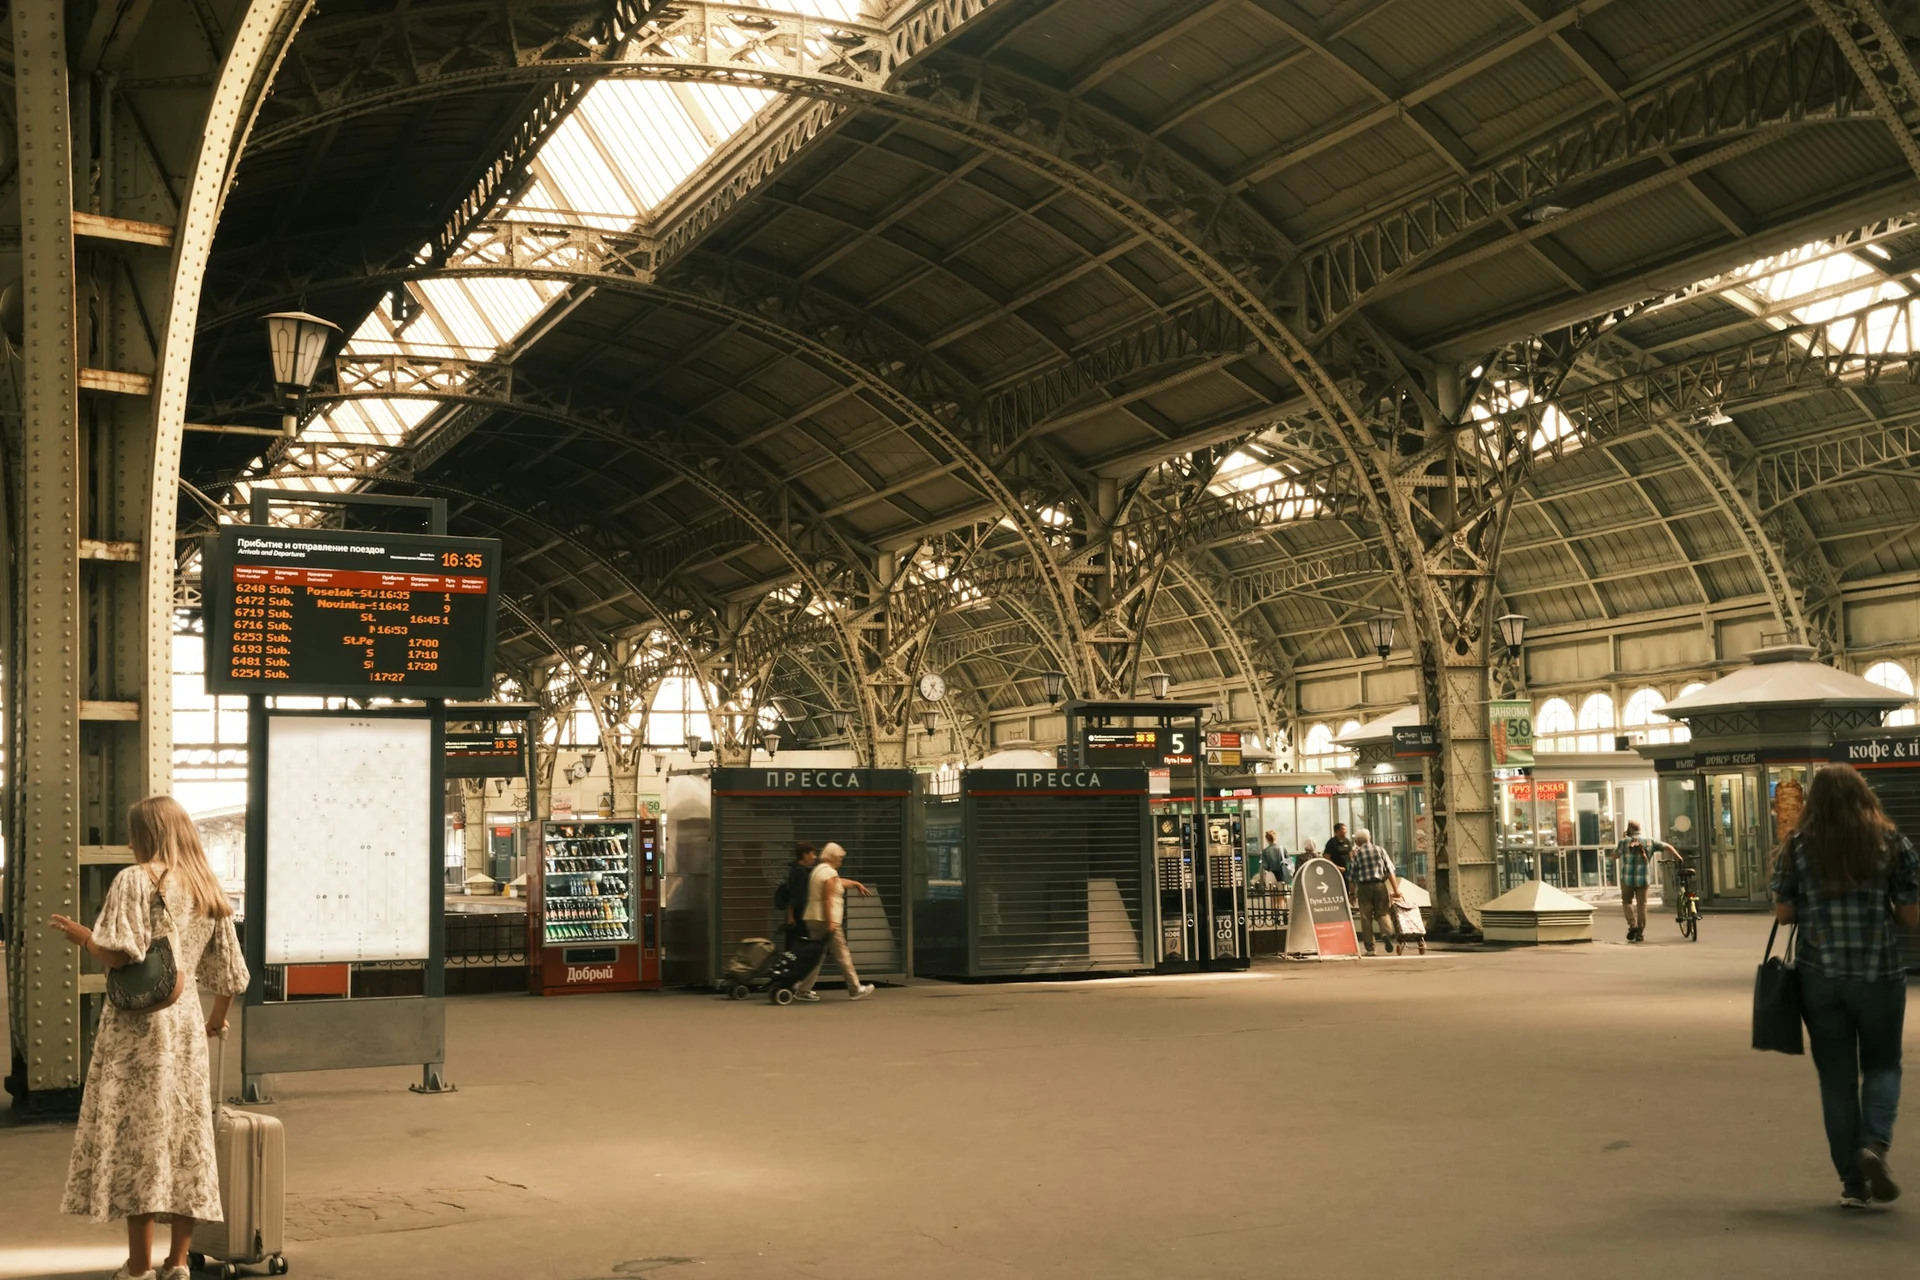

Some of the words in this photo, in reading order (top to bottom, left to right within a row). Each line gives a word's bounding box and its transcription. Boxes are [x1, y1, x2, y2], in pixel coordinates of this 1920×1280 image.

[237, 538, 283, 549] Прибытие
[292, 542, 348, 553] отправление
[350, 546, 385, 555] поездов
[441, 552, 482, 568] 16:35
[236, 584, 265, 593] 6248
[269, 586, 294, 594] Sub.
[380, 590, 410, 600] 16:35
[236, 596, 265, 605] 6472
[268, 597, 293, 606] Sub.
[379, 602, 409, 611] 16:42
[443, 605, 451, 613] 9
[235, 608, 264, 617] 6719
[268, 610, 292, 618] Sub.
[410, 615, 440, 624] 16:45
[234, 620, 263, 629] 6716
[267, 622, 292, 630] Sub.
[378, 626, 408, 634] 16:53
[233, 632, 263, 641] 6253
[266, 634, 291, 643] Sub.
[343, 636, 374, 645] St.Pe
[408, 638, 439, 647] 17:00
[233, 645, 262, 653] 6193
[266, 646, 290, 655] Sub.
[408, 650, 438, 659] 17:10
[232, 657, 261, 666] 6481
[265, 658, 290, 667] Sub.
[407, 662, 437, 671] 17:20
[231, 669, 260, 678] 6254
[264, 670, 289, 679] Sub.
[374, 672, 405, 681] 17:27
[1490, 706, 1529, 717] BAHROMA
[1508, 719, 1531, 737] 50
[1172, 734, 1184, 754] 5
[1849, 740, 1889, 762] кофе
[1894, 742, 1906, 757] &
[767, 772, 859, 787] ПРЕССА
[1017, 773, 1100, 787] ПРЕССА
[1509, 783, 1564, 793] ГРУЗНСКАЯ
[648, 801, 659, 810] 50
[1216, 919, 1232, 929] TO
[1217, 930, 1232, 939] GO
[567, 965, 613, 983] Добрый
